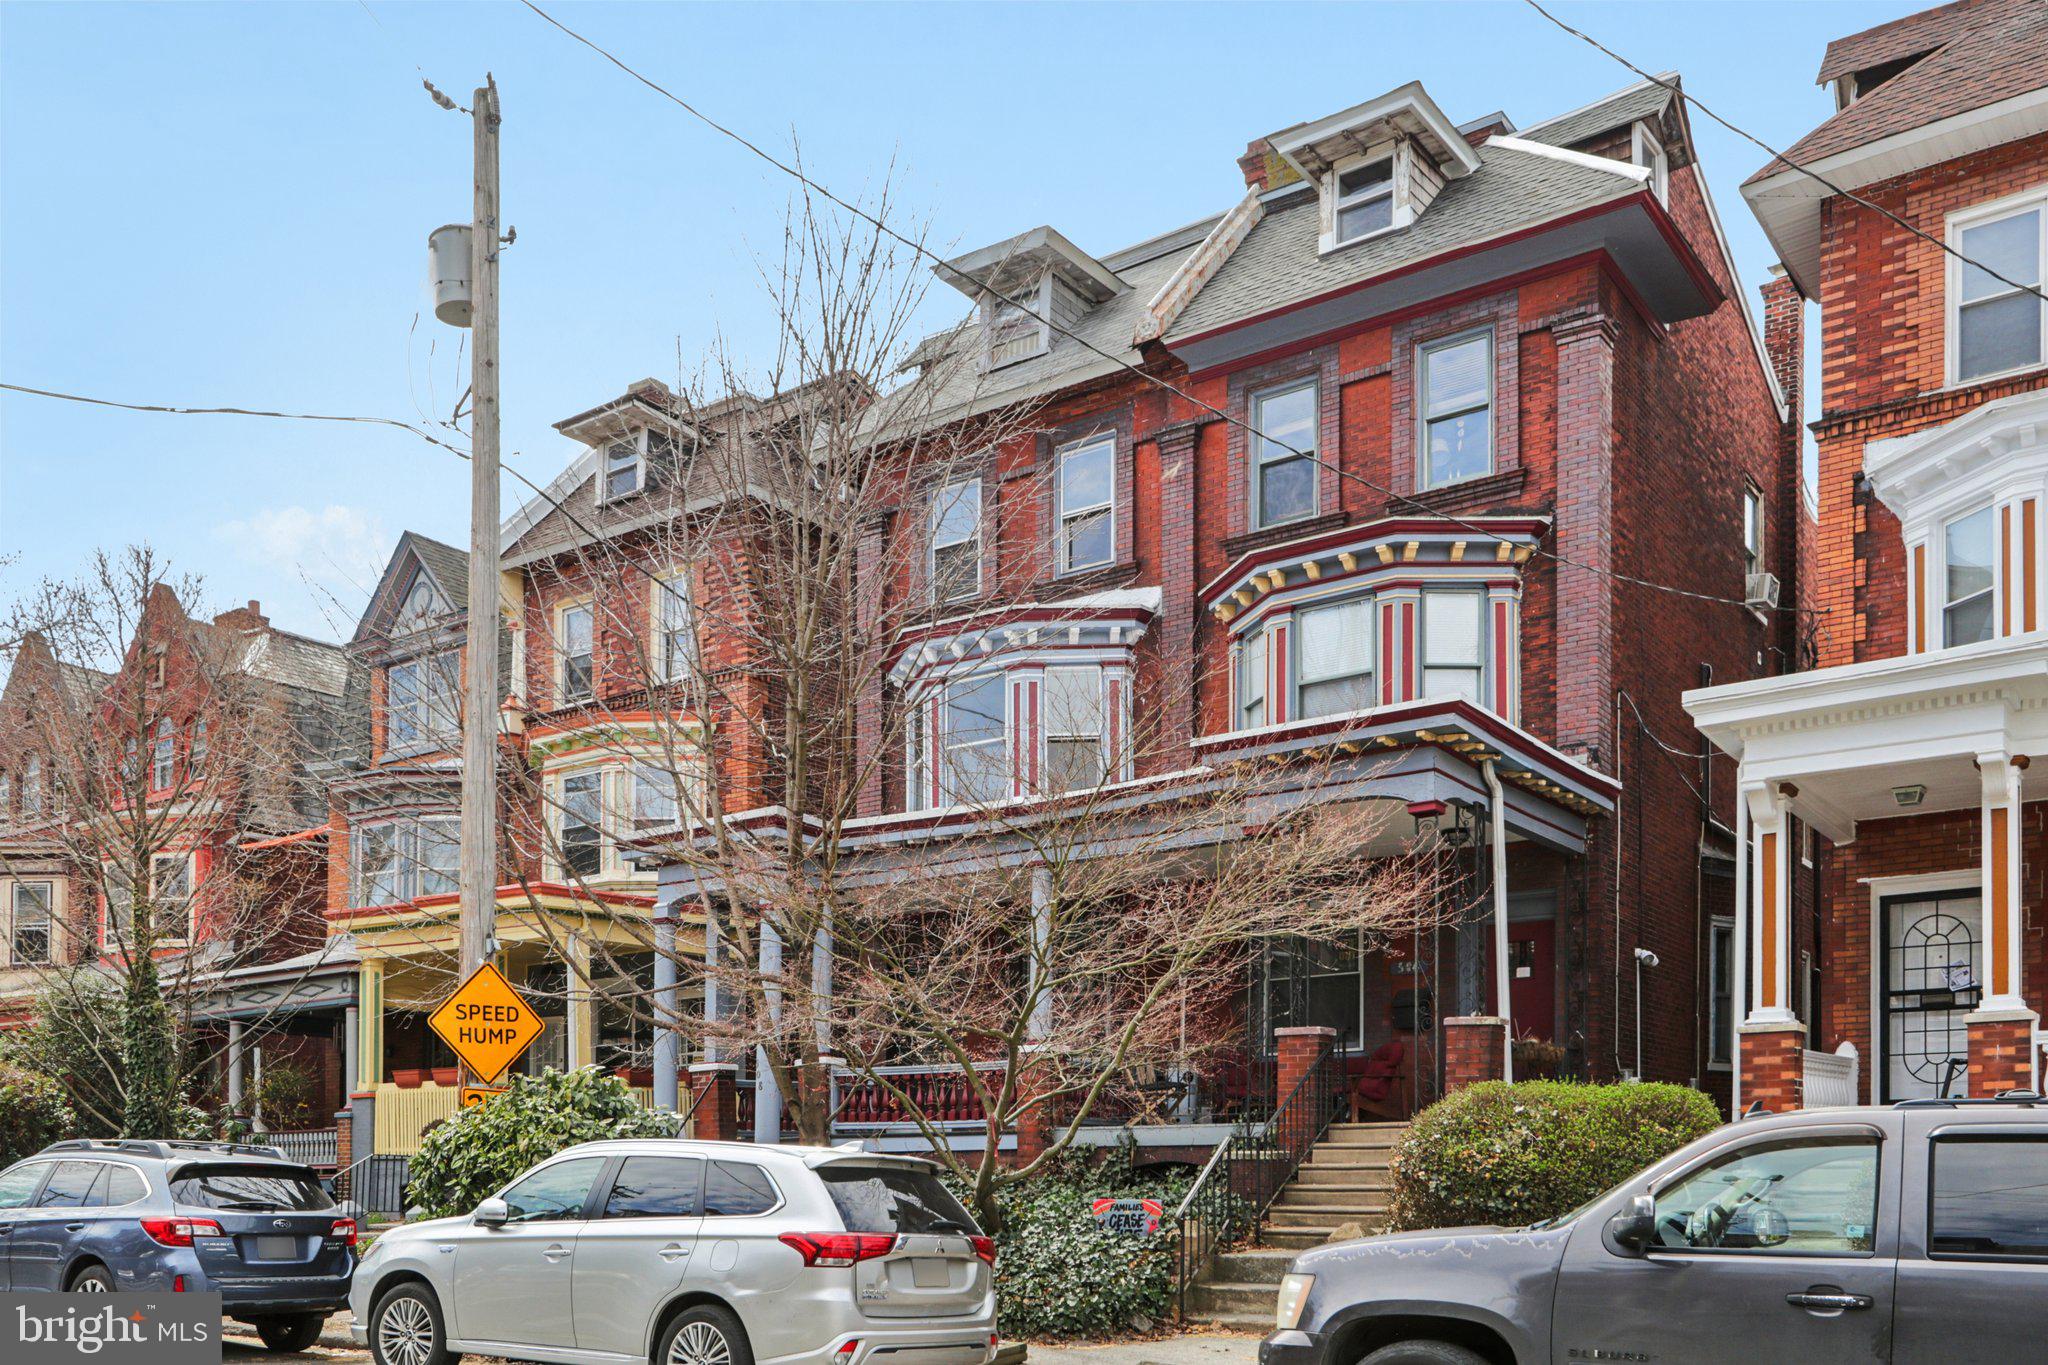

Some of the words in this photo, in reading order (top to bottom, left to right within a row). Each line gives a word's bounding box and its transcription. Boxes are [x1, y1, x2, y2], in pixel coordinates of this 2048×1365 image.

[456, 1004, 519, 1022] SPEED
[459, 1027, 517, 1045] HUMP
[1109, 1213, 1146, 1230] CEASE
